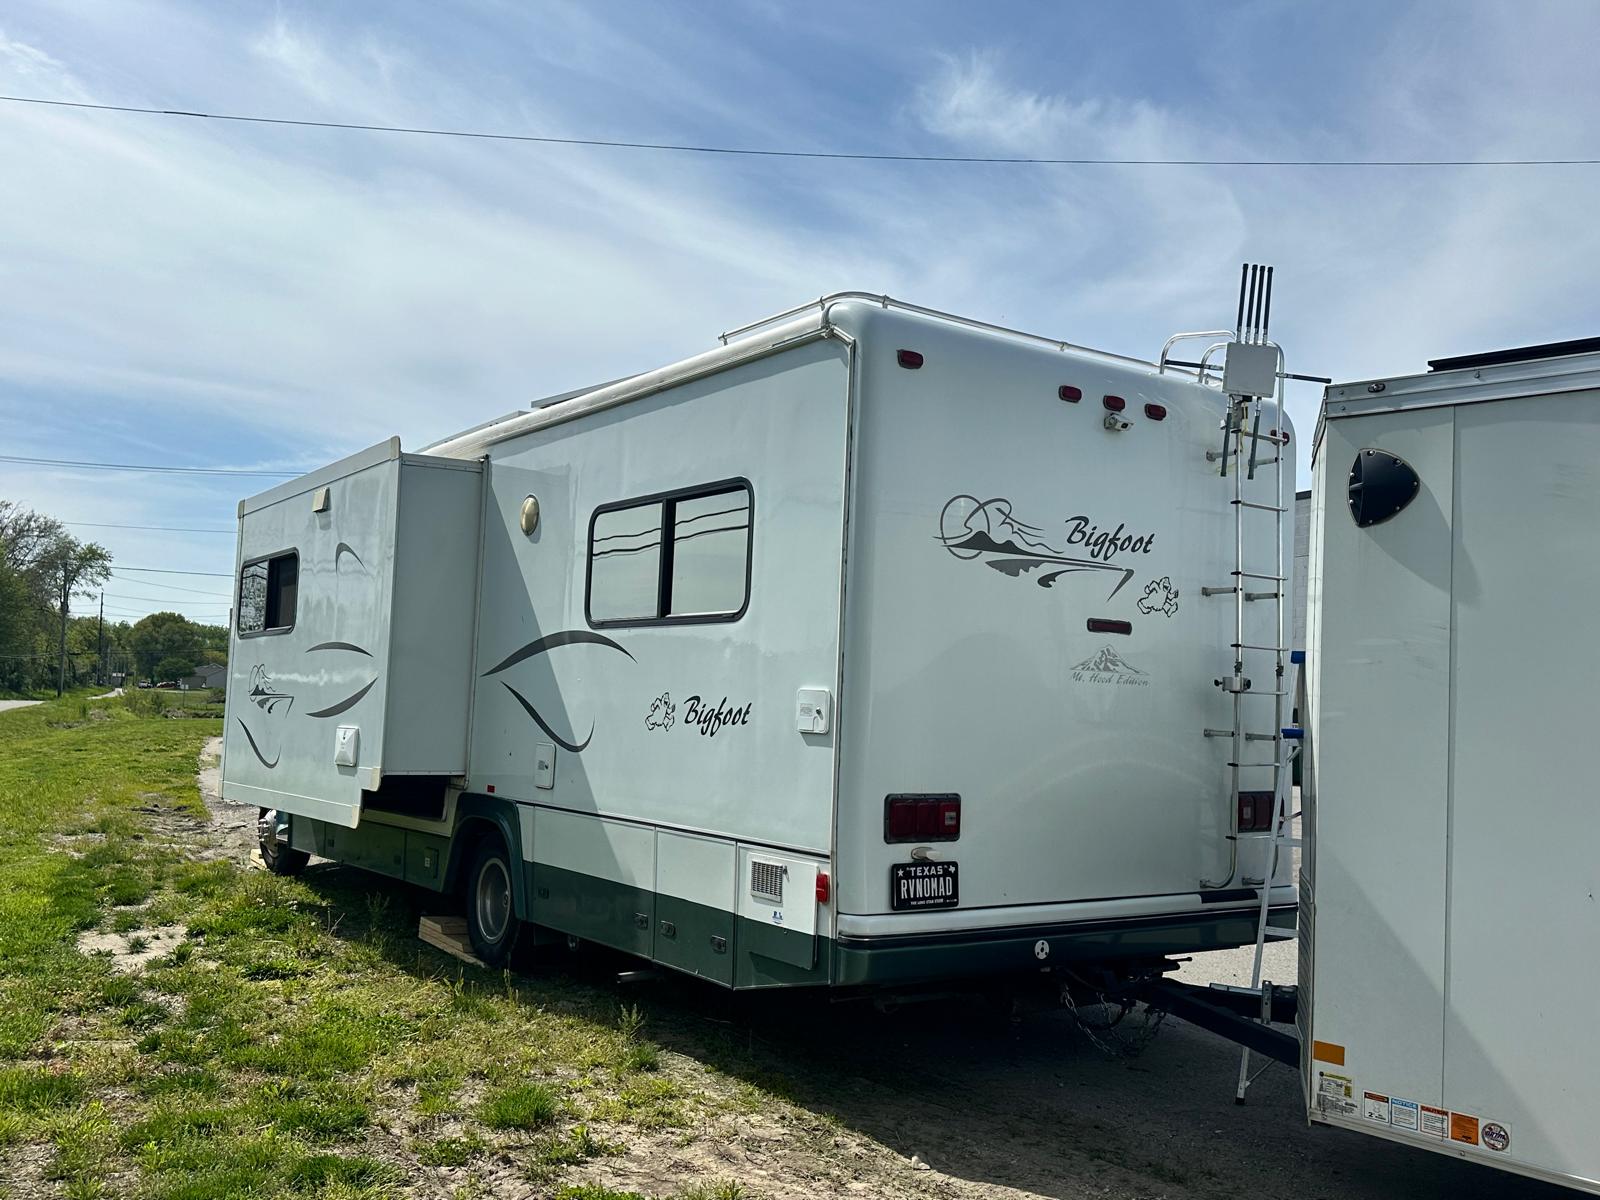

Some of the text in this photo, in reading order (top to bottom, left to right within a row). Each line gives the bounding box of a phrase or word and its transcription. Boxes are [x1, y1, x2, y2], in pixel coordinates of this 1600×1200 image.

[1065, 515, 1155, 561] Bigfoot
[1088, 673, 1114, 684] Hood
[683, 695, 752, 738] Bigfoot
[910, 865, 943, 877] TEXAS
[900, 877, 952, 900] RVNOMAD
[1391, 1098, 1417, 1109] NOTICE
